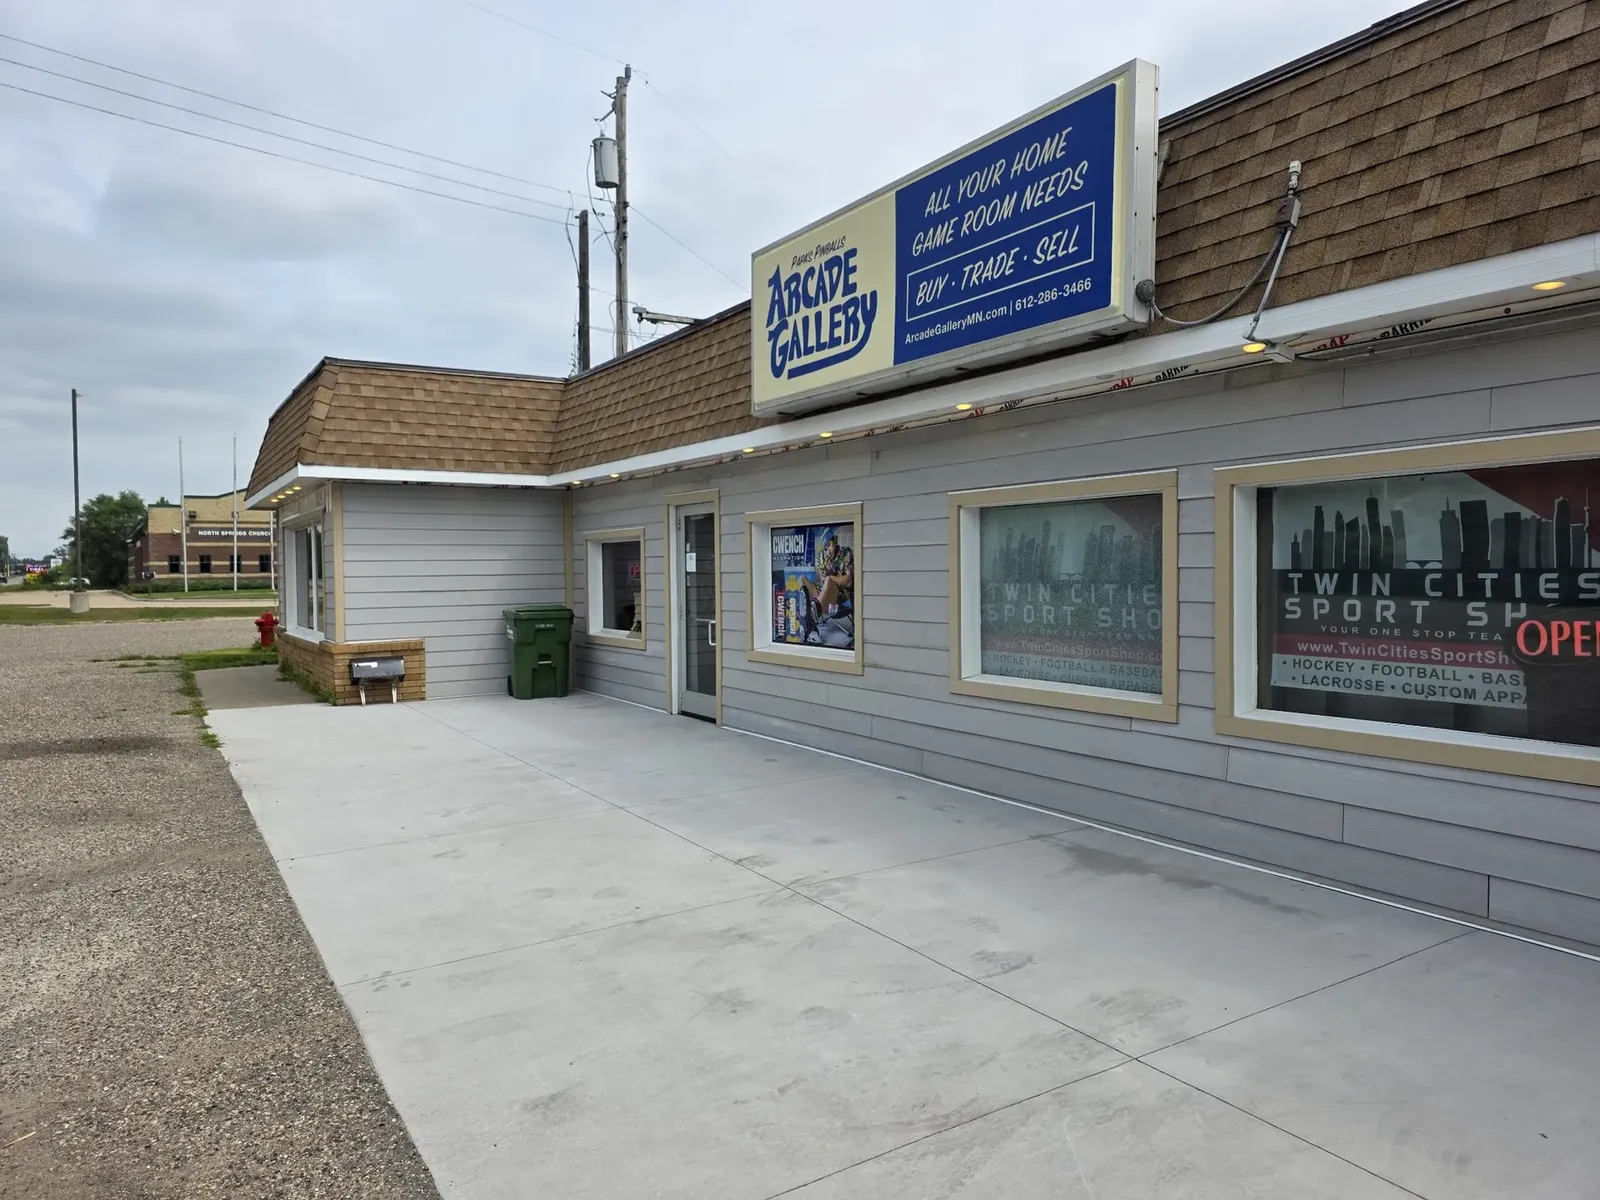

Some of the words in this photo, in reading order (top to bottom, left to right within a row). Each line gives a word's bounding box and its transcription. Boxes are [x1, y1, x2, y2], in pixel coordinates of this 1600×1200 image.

[924, 184, 951, 218] ALL
[957, 158, 1006, 204] YOUR
[1010, 126, 1073, 180] HOME
[912, 216, 959, 257] GAME
[960, 190, 1017, 238] ROOM
[1020, 160, 1089, 213] NEEDS
[814, 235, 846, 260] PINBALLS
[915, 272, 949, 306] BUY
[961, 246, 1020, 291] TRADE
[1032, 224, 1080, 265] SELL
[765, 247, 858, 329] ARCADE
[904, 305, 1008, 345] ArcadeGalleryMN.com
[1015, 277, 1092, 311] 612-286-3466
[767, 289, 878, 380] GALLERY
[772, 534, 805, 554] CWENCH
[988, 582, 1051, 602] TWIN
[1288, 572, 1391, 596] TWIN
[1423, 572, 1600, 600] CITIES
[986, 603, 1075, 626] SPORT
[1284, 597, 1430, 625] SPORT
[1466, 601, 1528, 628] SH
[1320, 625, 1359, 634] YOUR
[1370, 627, 1401, 637] ONE
[1412, 629, 1456, 639] STOP
[1516, 619, 1600, 657] OPE
[993, 652, 1031, 667] HOCKEY
[1040, 658, 1097, 673] FOOTBALL
[1109, 664, 1162, 680] BASEBA
[1297, 641, 1516, 666] www.TwinCitiesSportSh
[1292, 658, 1355, 674] HOCKEY
[1371, 663, 1463, 682] FOOTBALL
[1482, 672, 1527, 687] BAS
[1301, 674, 1385, 693] LACROSSE
[1402, 682, 1477, 701] CUSTOM
